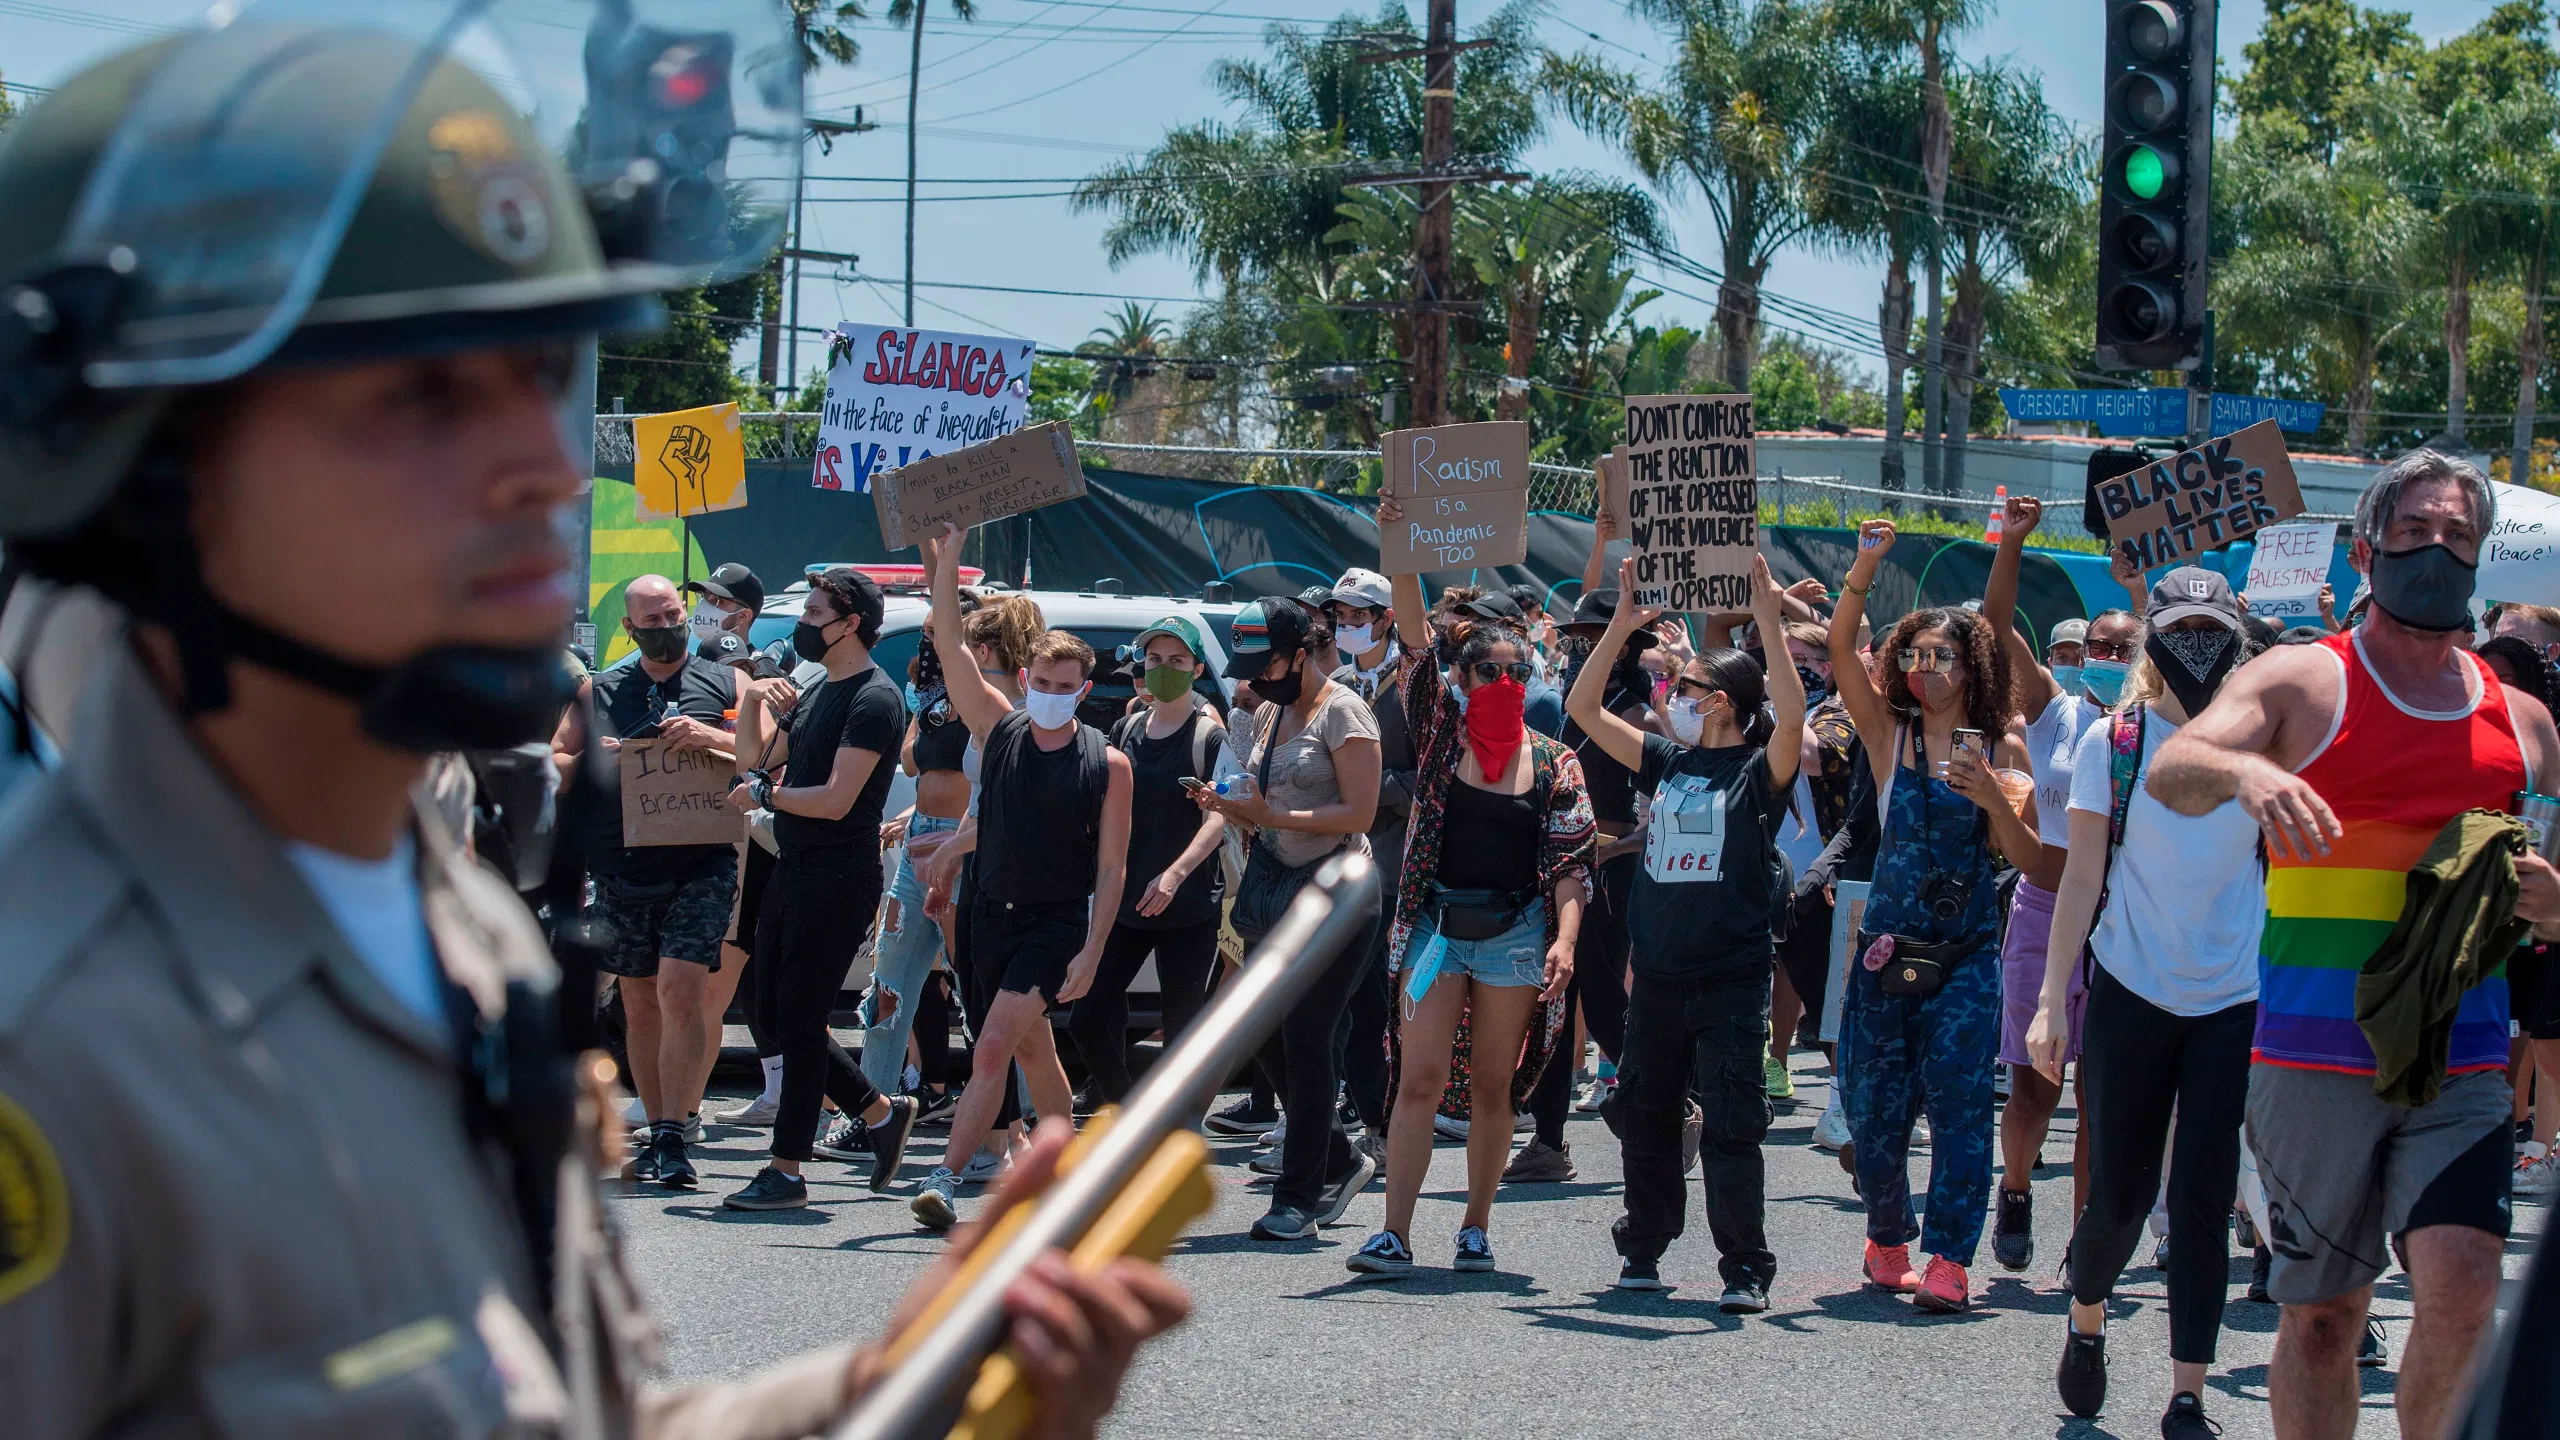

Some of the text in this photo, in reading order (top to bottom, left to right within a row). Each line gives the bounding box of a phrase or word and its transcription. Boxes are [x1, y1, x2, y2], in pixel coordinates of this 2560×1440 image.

[843, 399, 867, 431] the
[870, 396, 904, 434] face
[913, 405, 932, 435] of
[2018, 393, 2088, 416] CRESCENT
[2096, 394, 2151, 416] HEIGHTS
[2215, 397, 2317, 427] SANTA MONICA BLVD
[1627, 400, 1754, 447] DONT CONFUSE
[909, 473, 938, 491] mins
[945, 462, 959, 476] to
[967, 449, 1002, 469] KILL
[1413, 436, 1502, 494] Racism
[1628, 443, 1749, 482] THE REACTION
[2101, 438, 2245, 520] BLACK
[934, 462, 1011, 500] BLACK MAN
[2164, 467, 2265, 527] LIVES
[908, 514, 920, 533] 3
[923, 510, 953, 527] days
[957, 505, 971, 515] to
[979, 476, 1031, 508] ARREST
[981, 485, 1067, 521] MURDERER.
[1434, 497, 1468, 516] is a
[1629, 478, 1757, 518] OF THE OPRESSED
[1410, 522, 1496, 551] Pandemic
[1631, 516, 1755, 553] W/ THE VIOLENCE
[2121, 495, 2278, 572] MATTER
[2491, 518, 2547, 536] stice,
[1433, 545, 1475, 567] TOO
[2258, 531, 2319, 562] FREE
[2489, 540, 2552, 562] Peace!
[1637, 550, 1696, 583] OF THE
[2248, 567, 2326, 590] PALESTINE
[1634, 585, 1668, 609] BLM!
[2247, 600, 2305, 616] ACAB
[694, 614, 719, 627] BLM
[1915, 736, 1923, 753] EOS
[634, 745, 657, 780] I
[1667, 846, 1718, 871] ICE
